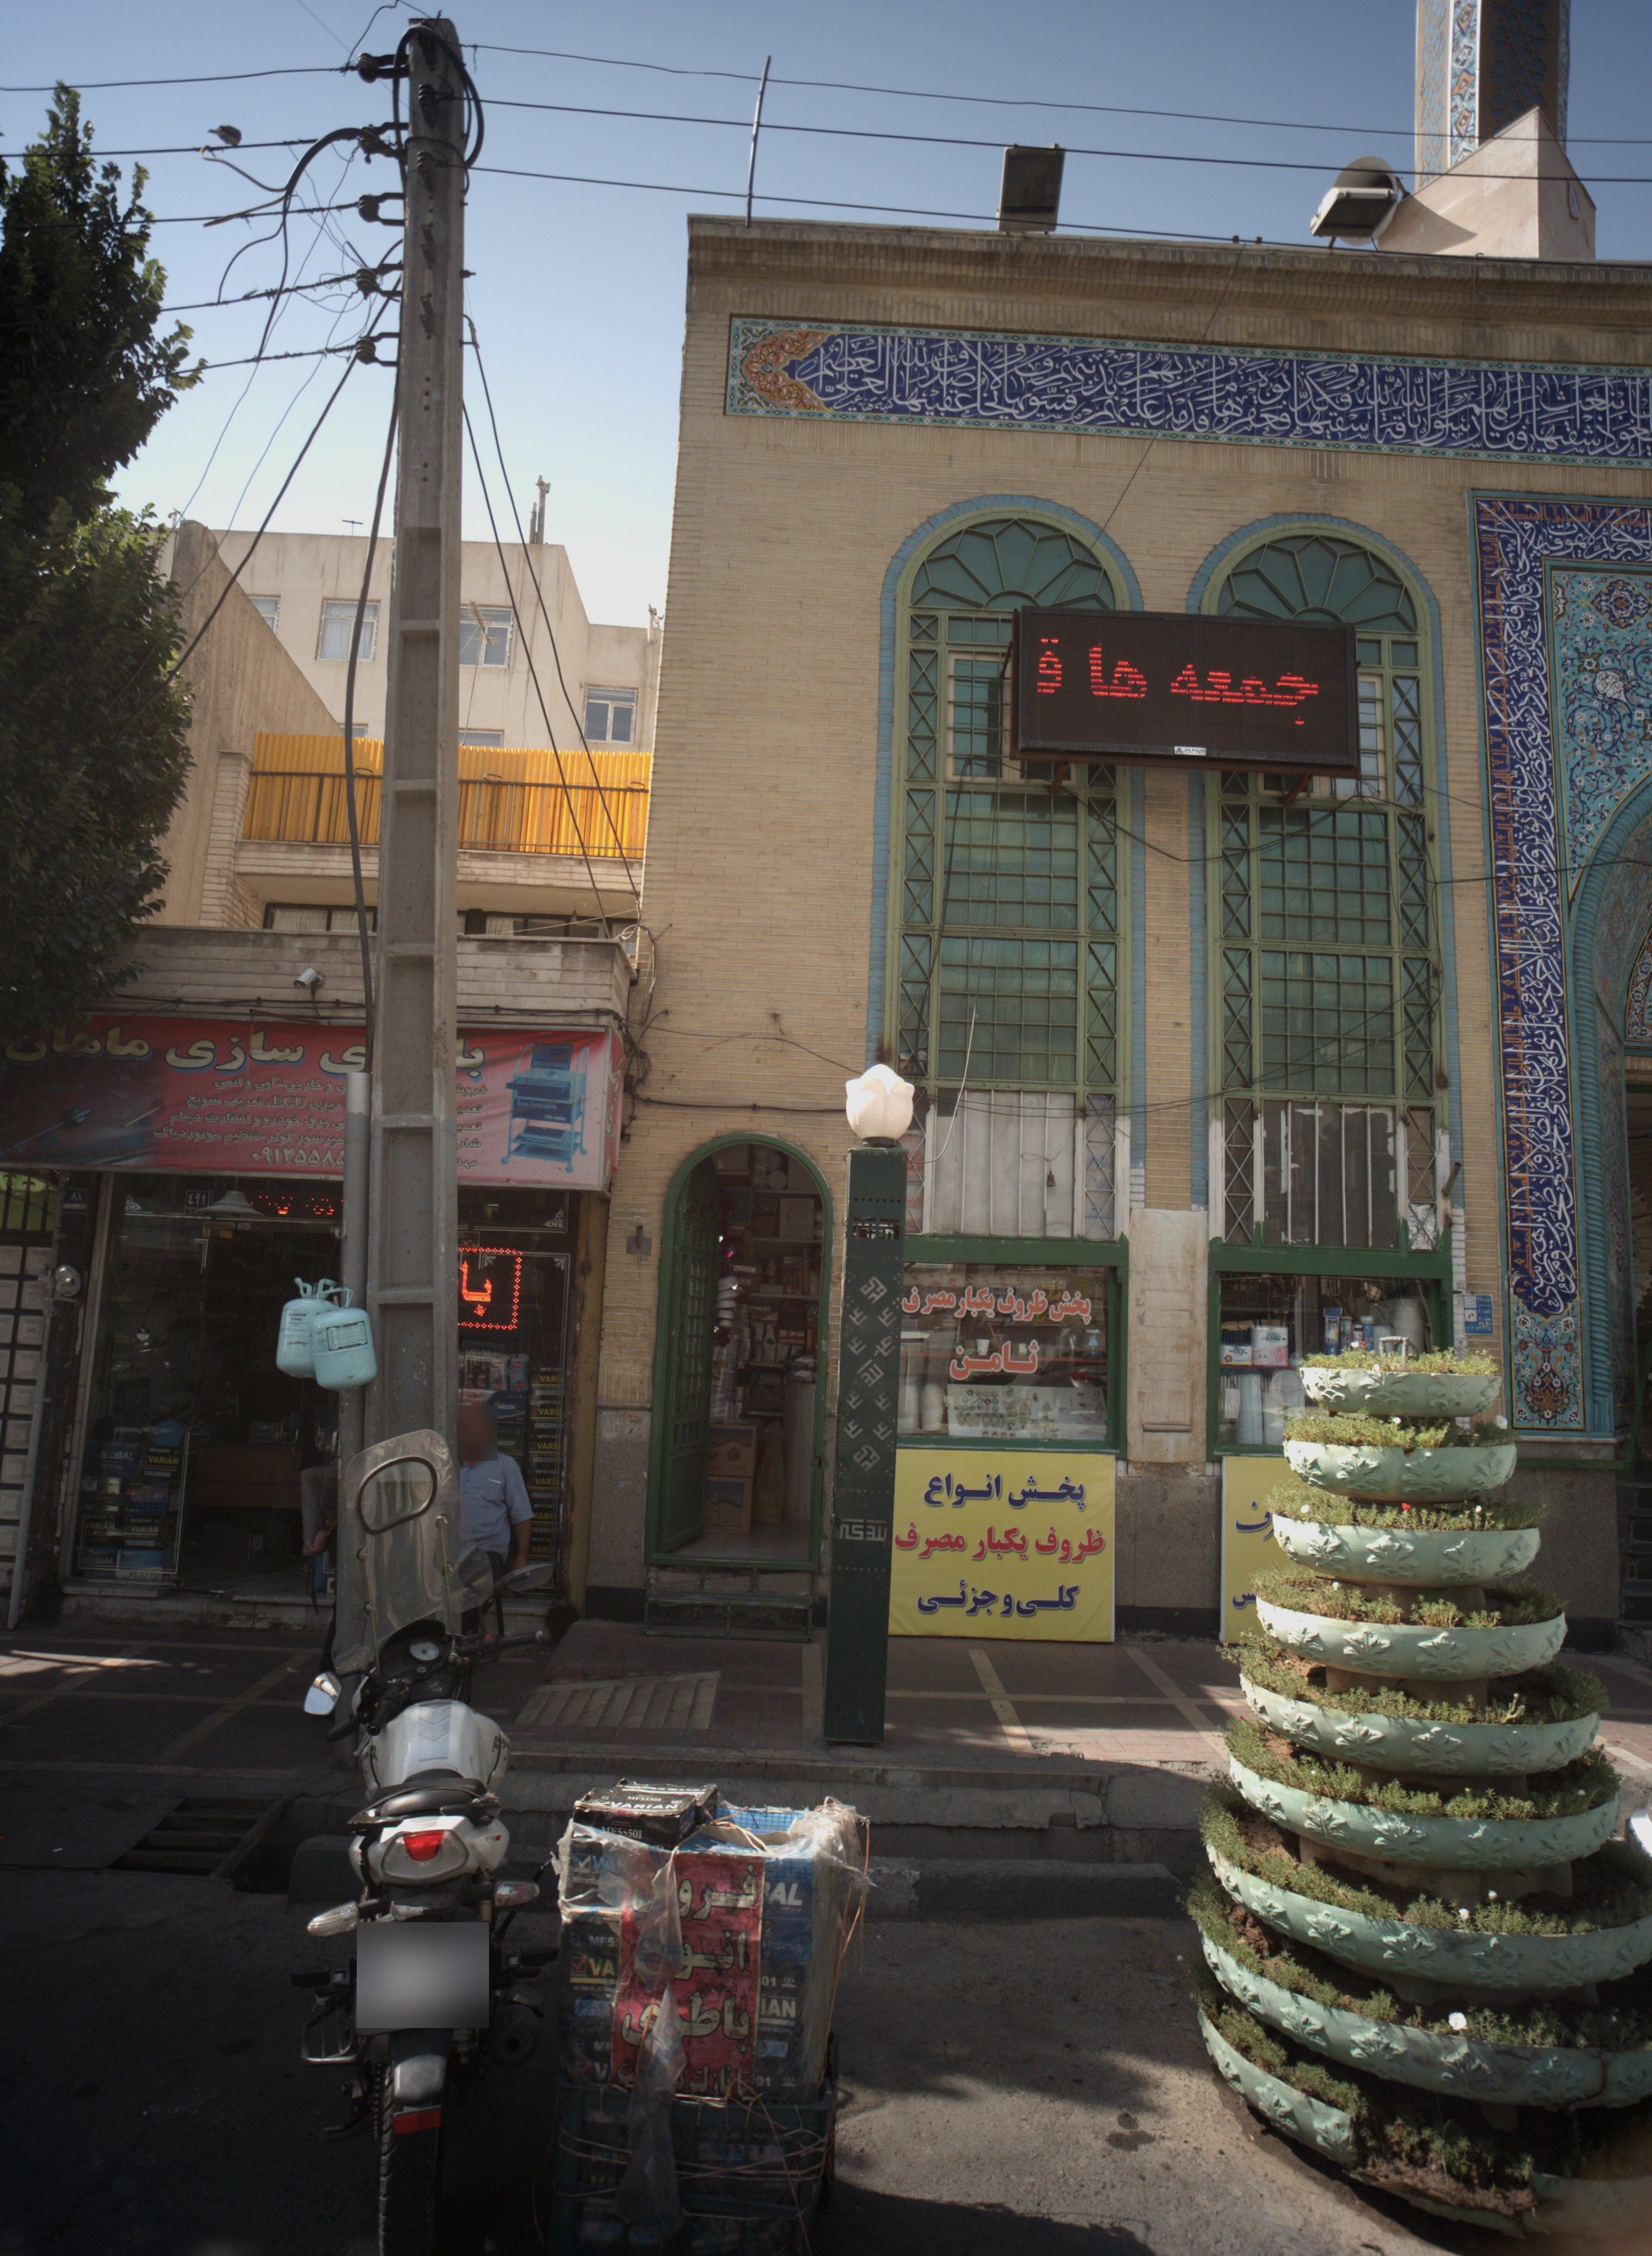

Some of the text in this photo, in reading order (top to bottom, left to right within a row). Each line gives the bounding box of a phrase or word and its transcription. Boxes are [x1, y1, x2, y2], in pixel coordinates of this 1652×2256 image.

[5, 1025, 150, 1061] ماهان
[166, 1031, 303, 1070] سازی
[457, 1104, 482, 1115] تعمی
[457, 1122, 482, 1133] تعمی
[297, 1133, 345, 1147] مپرسور
[460, 1260, 492, 1317] با
[903, 1287, 1091, 1324] پخش ظروف یکبار مصرف
[950, 1340, 1039, 1379] ثامن
[149, 1456, 179, 1465] VARIAN
[923, 1472, 1086, 1511] پخش انواع
[894, 1521, 966, 1559] مصرف
[971, 1526, 1028, 1560] یکبار
[1035, 1526, 1106, 1563] ظروف
[917, 1579, 1080, 1616] کلی و جزئی
[611, 1801, 679, 1809] VARIAN
[760, 1997, 796, 2018] IAN
